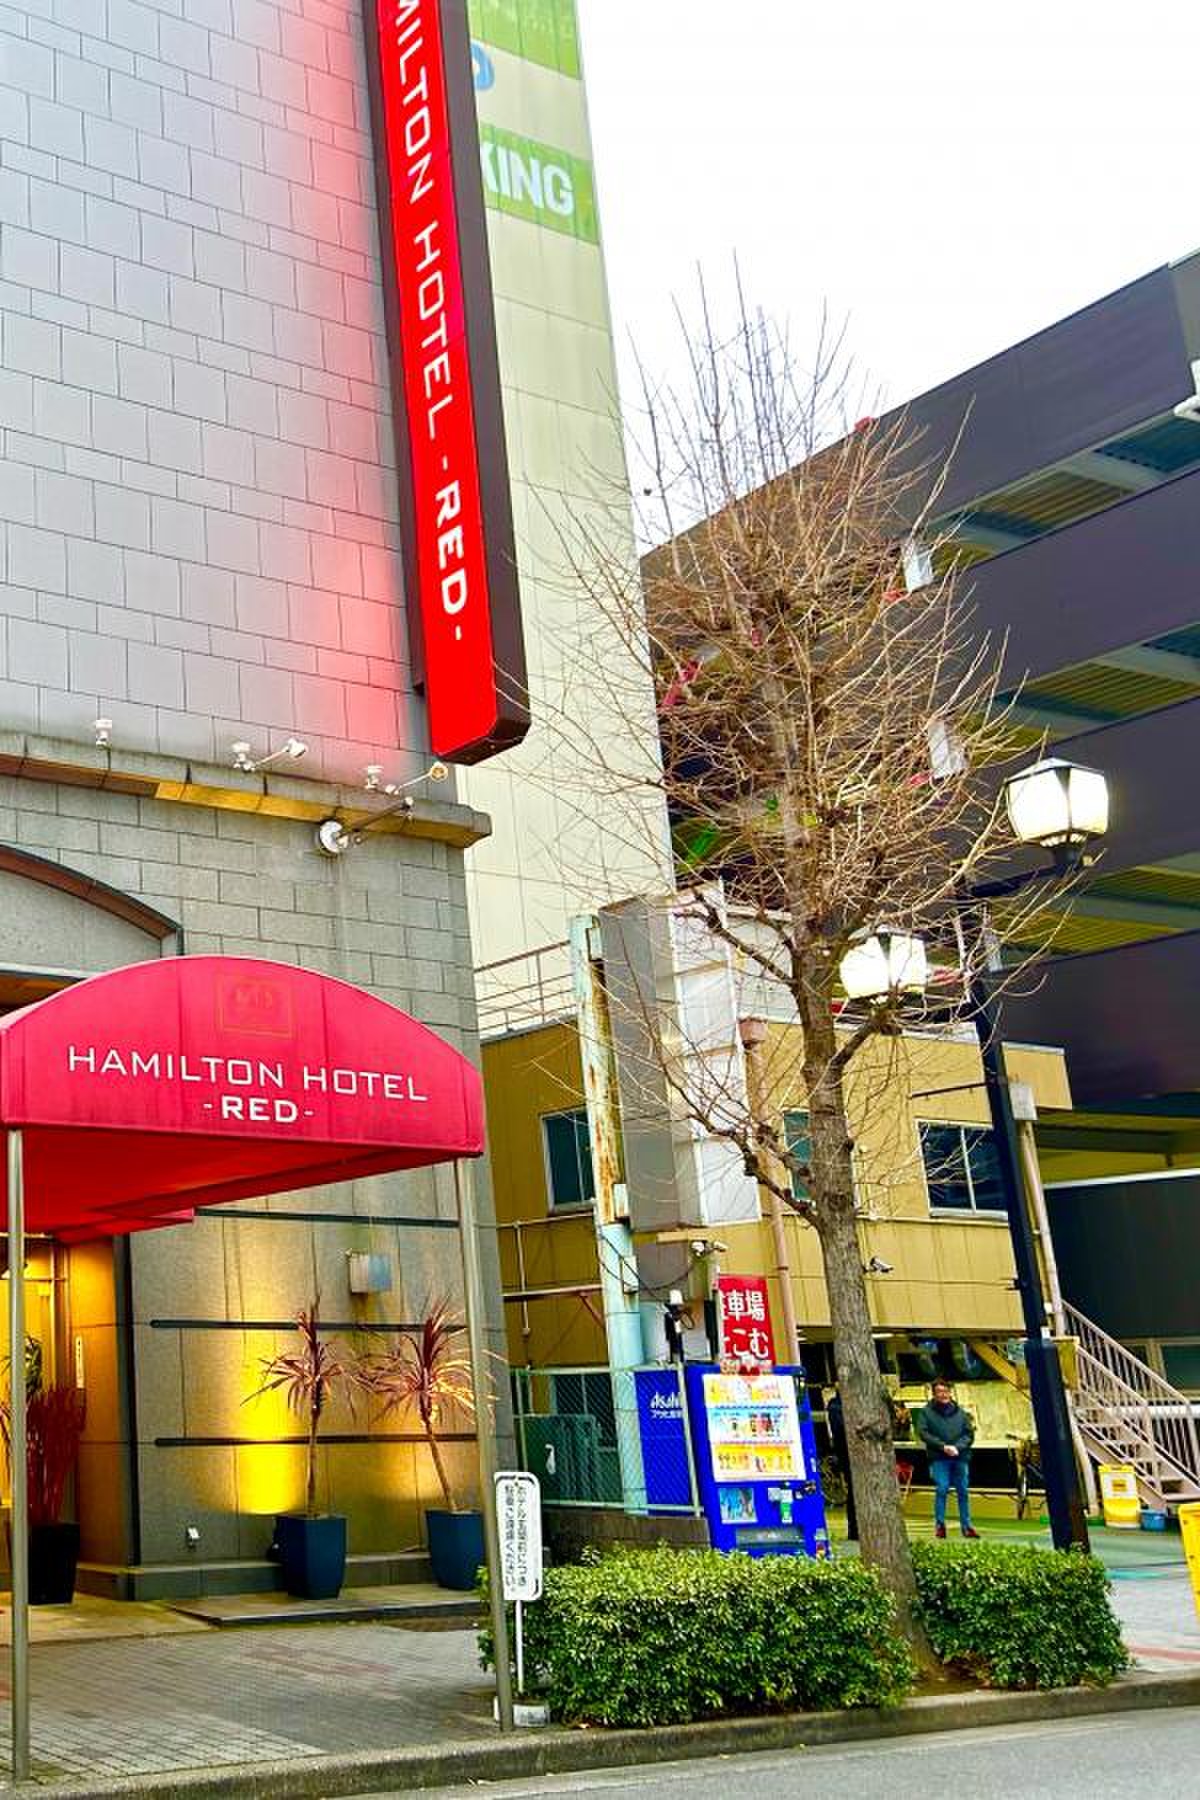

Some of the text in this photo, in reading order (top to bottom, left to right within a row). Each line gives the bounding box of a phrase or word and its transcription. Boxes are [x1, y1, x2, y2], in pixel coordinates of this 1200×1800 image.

[414, 221, 452, 439] HOTEL
[68, 1045, 428, 1102] HAMILTON HOTEL
